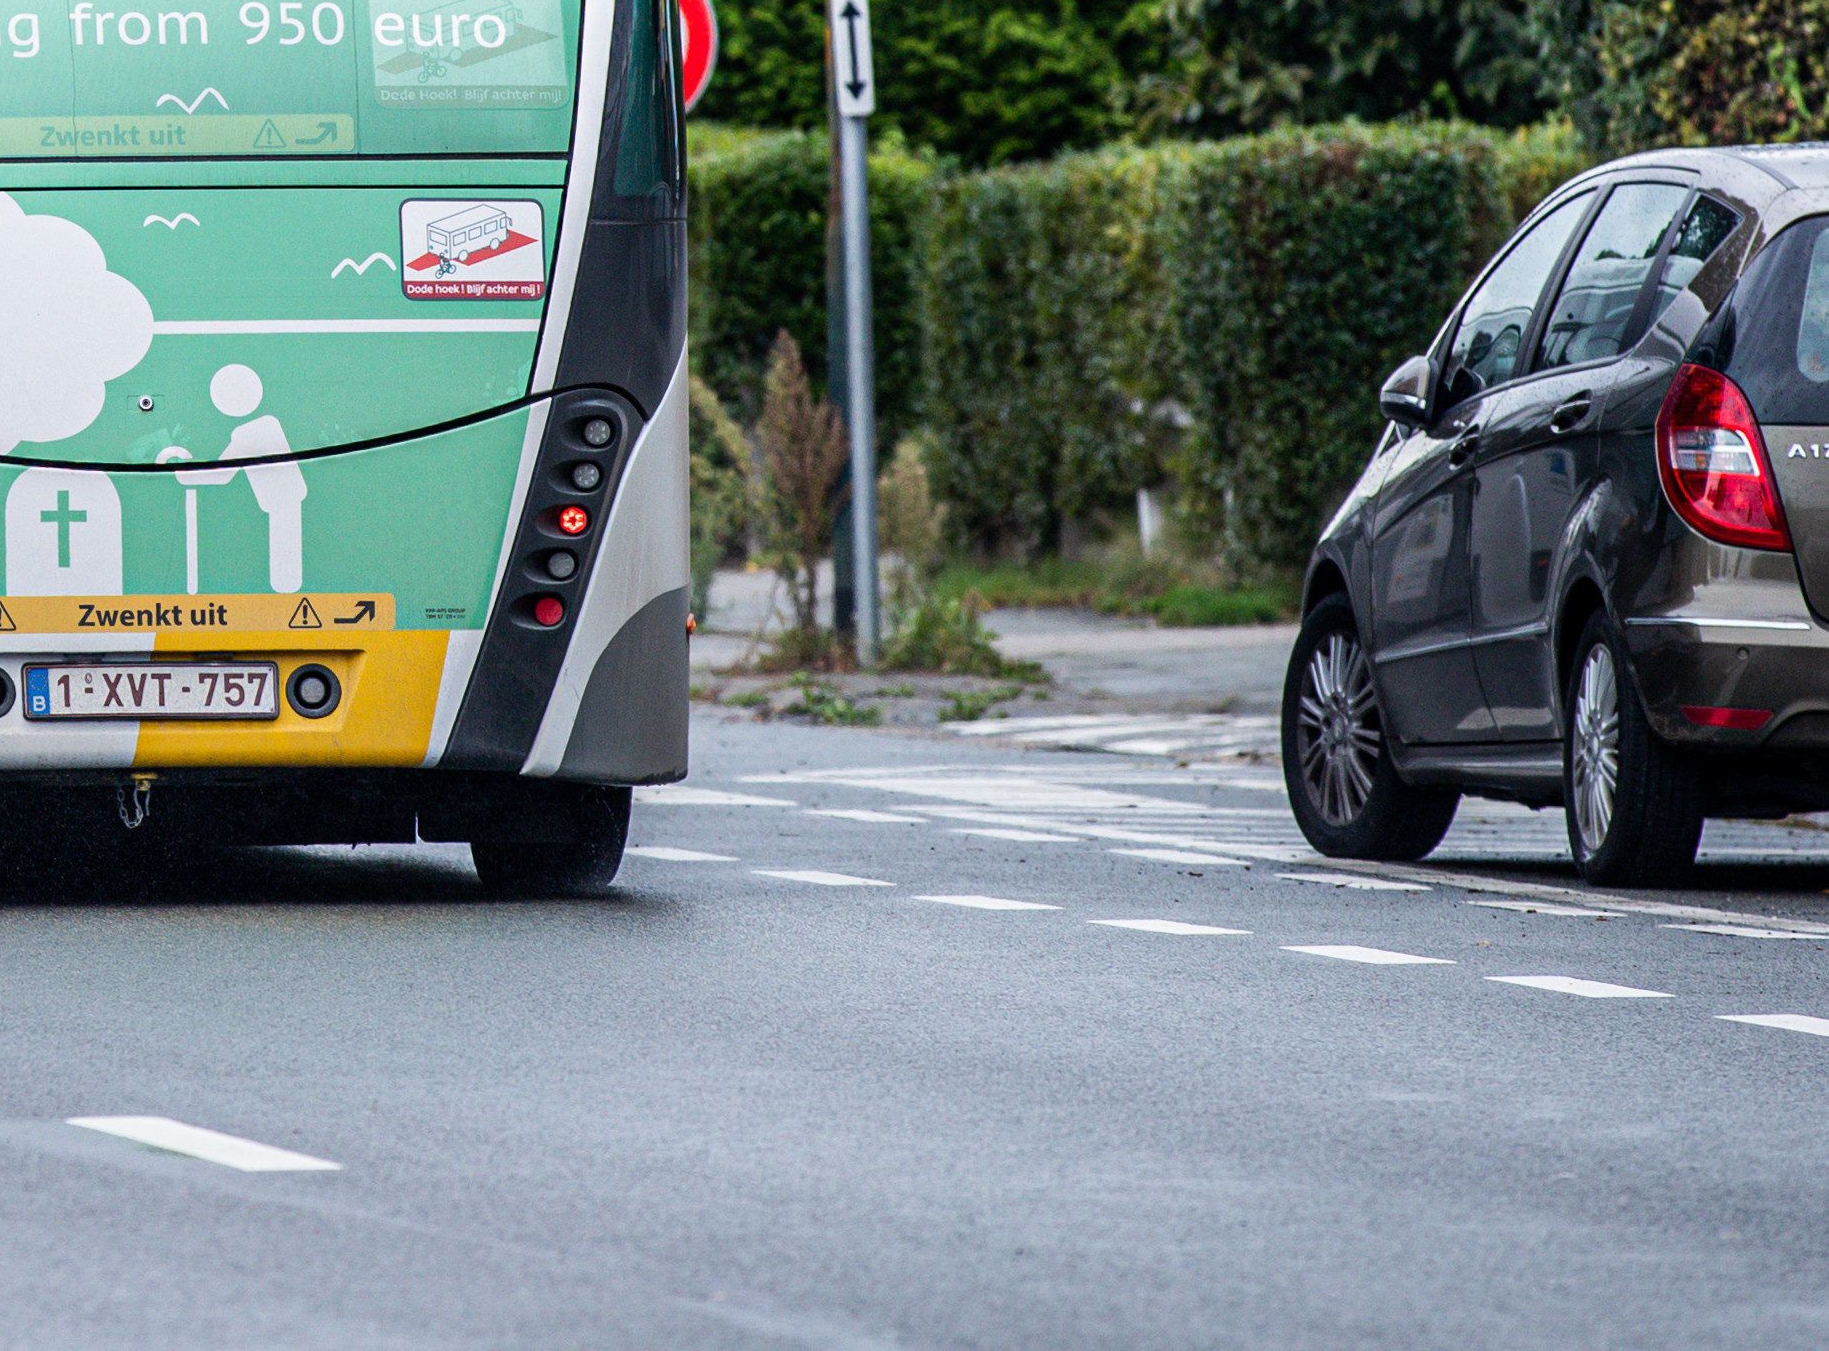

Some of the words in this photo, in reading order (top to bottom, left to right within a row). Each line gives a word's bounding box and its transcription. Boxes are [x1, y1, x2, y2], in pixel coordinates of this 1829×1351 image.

[69, 2, 209, 47] from
[238, 2, 345, 47] 950
[374, 12, 507, 49] euro
[40, 124, 141, 148] Zwenkt
[149, 124, 187, 146] uit
[407, 284, 433, 294] Dode
[467, 284, 485, 296] Blijf
[486, 284, 519, 294] achter
[78, 602, 182, 627] Zwenkt
[190, 602, 228, 626] uit
[33, 695, 46, 712] B
